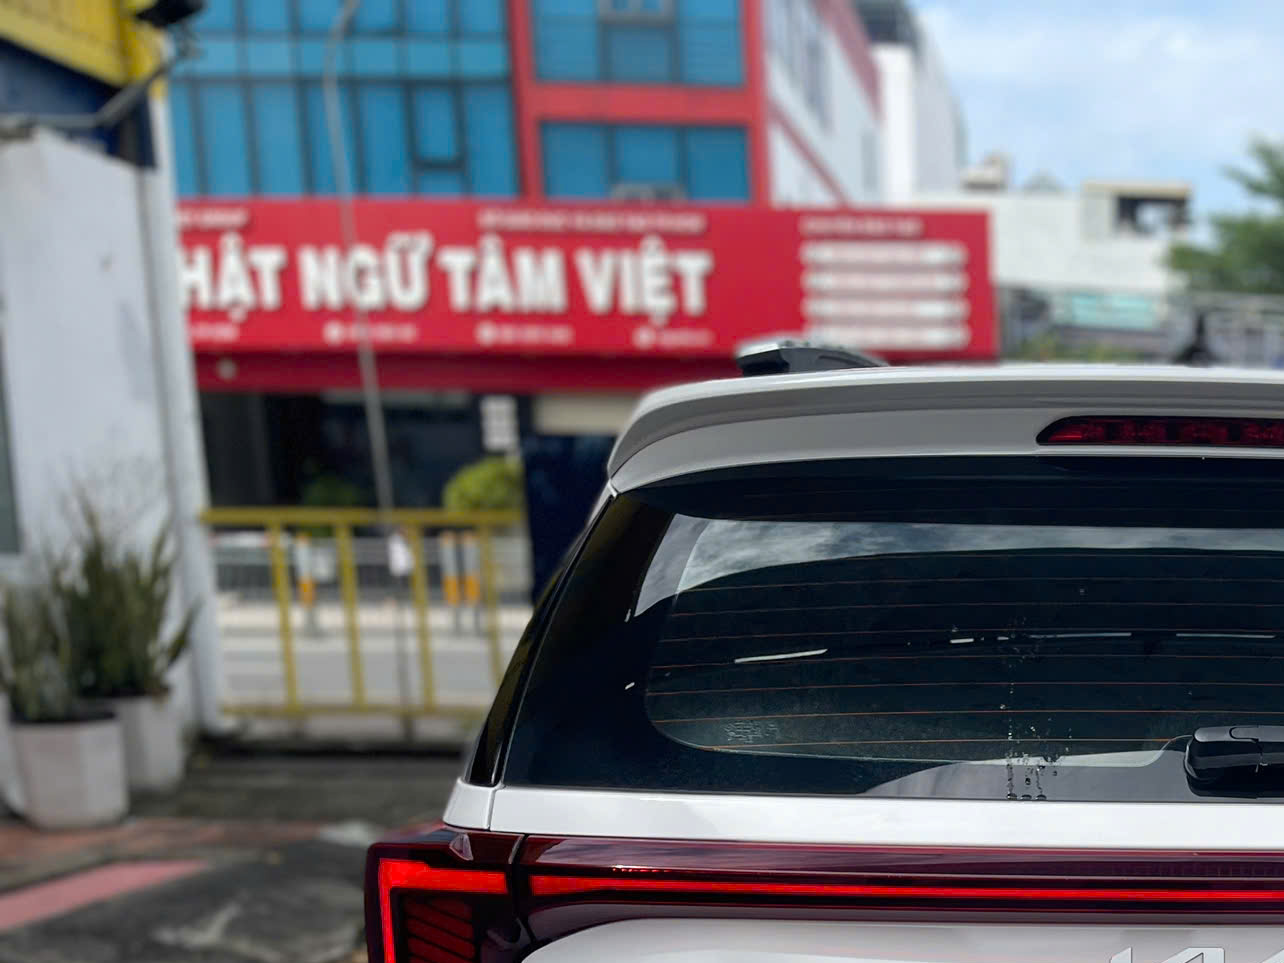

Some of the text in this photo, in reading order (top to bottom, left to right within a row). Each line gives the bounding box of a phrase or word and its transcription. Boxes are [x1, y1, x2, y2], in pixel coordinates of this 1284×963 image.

[177, 231, 714, 326] HẬT NGỮ TÂM VIỆT
